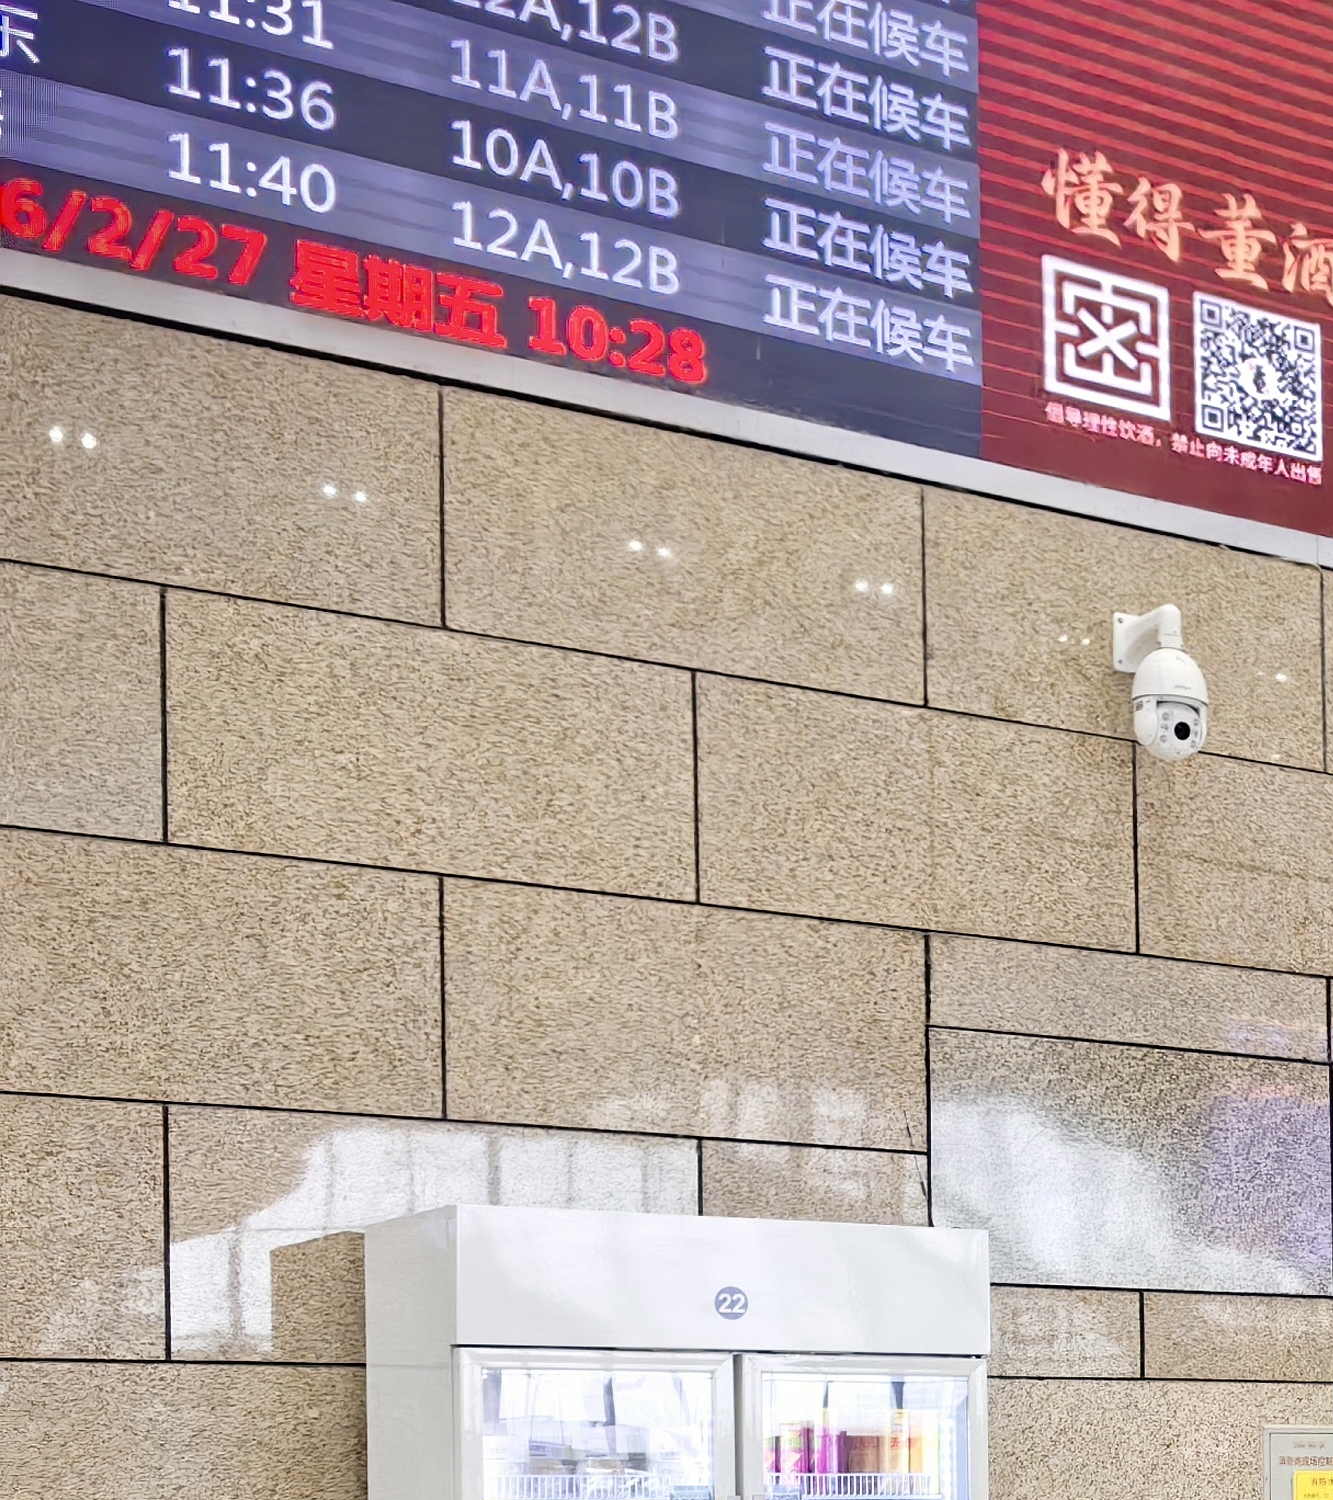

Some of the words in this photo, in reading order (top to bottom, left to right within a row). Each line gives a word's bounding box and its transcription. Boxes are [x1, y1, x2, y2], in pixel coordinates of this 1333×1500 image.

[167, 47, 337, 131] 11:36
[450, 119, 681, 220] 10A,10B
[763, 197, 973, 299] 正在候车
[450, 38, 680, 141] 11A,11B
[763, 121, 972, 225] 正在候车
[763, 45, 971, 152] 正在候车
[167, 131, 337, 214] 11:40
[451, 200, 681, 296] 12A,12B
[763, 273, 975, 374] 正在候车
[289, 239, 508, 349] 星期五
[527, 297, 709, 385] 10:28
[718, 1293, 746, 1314] 22
